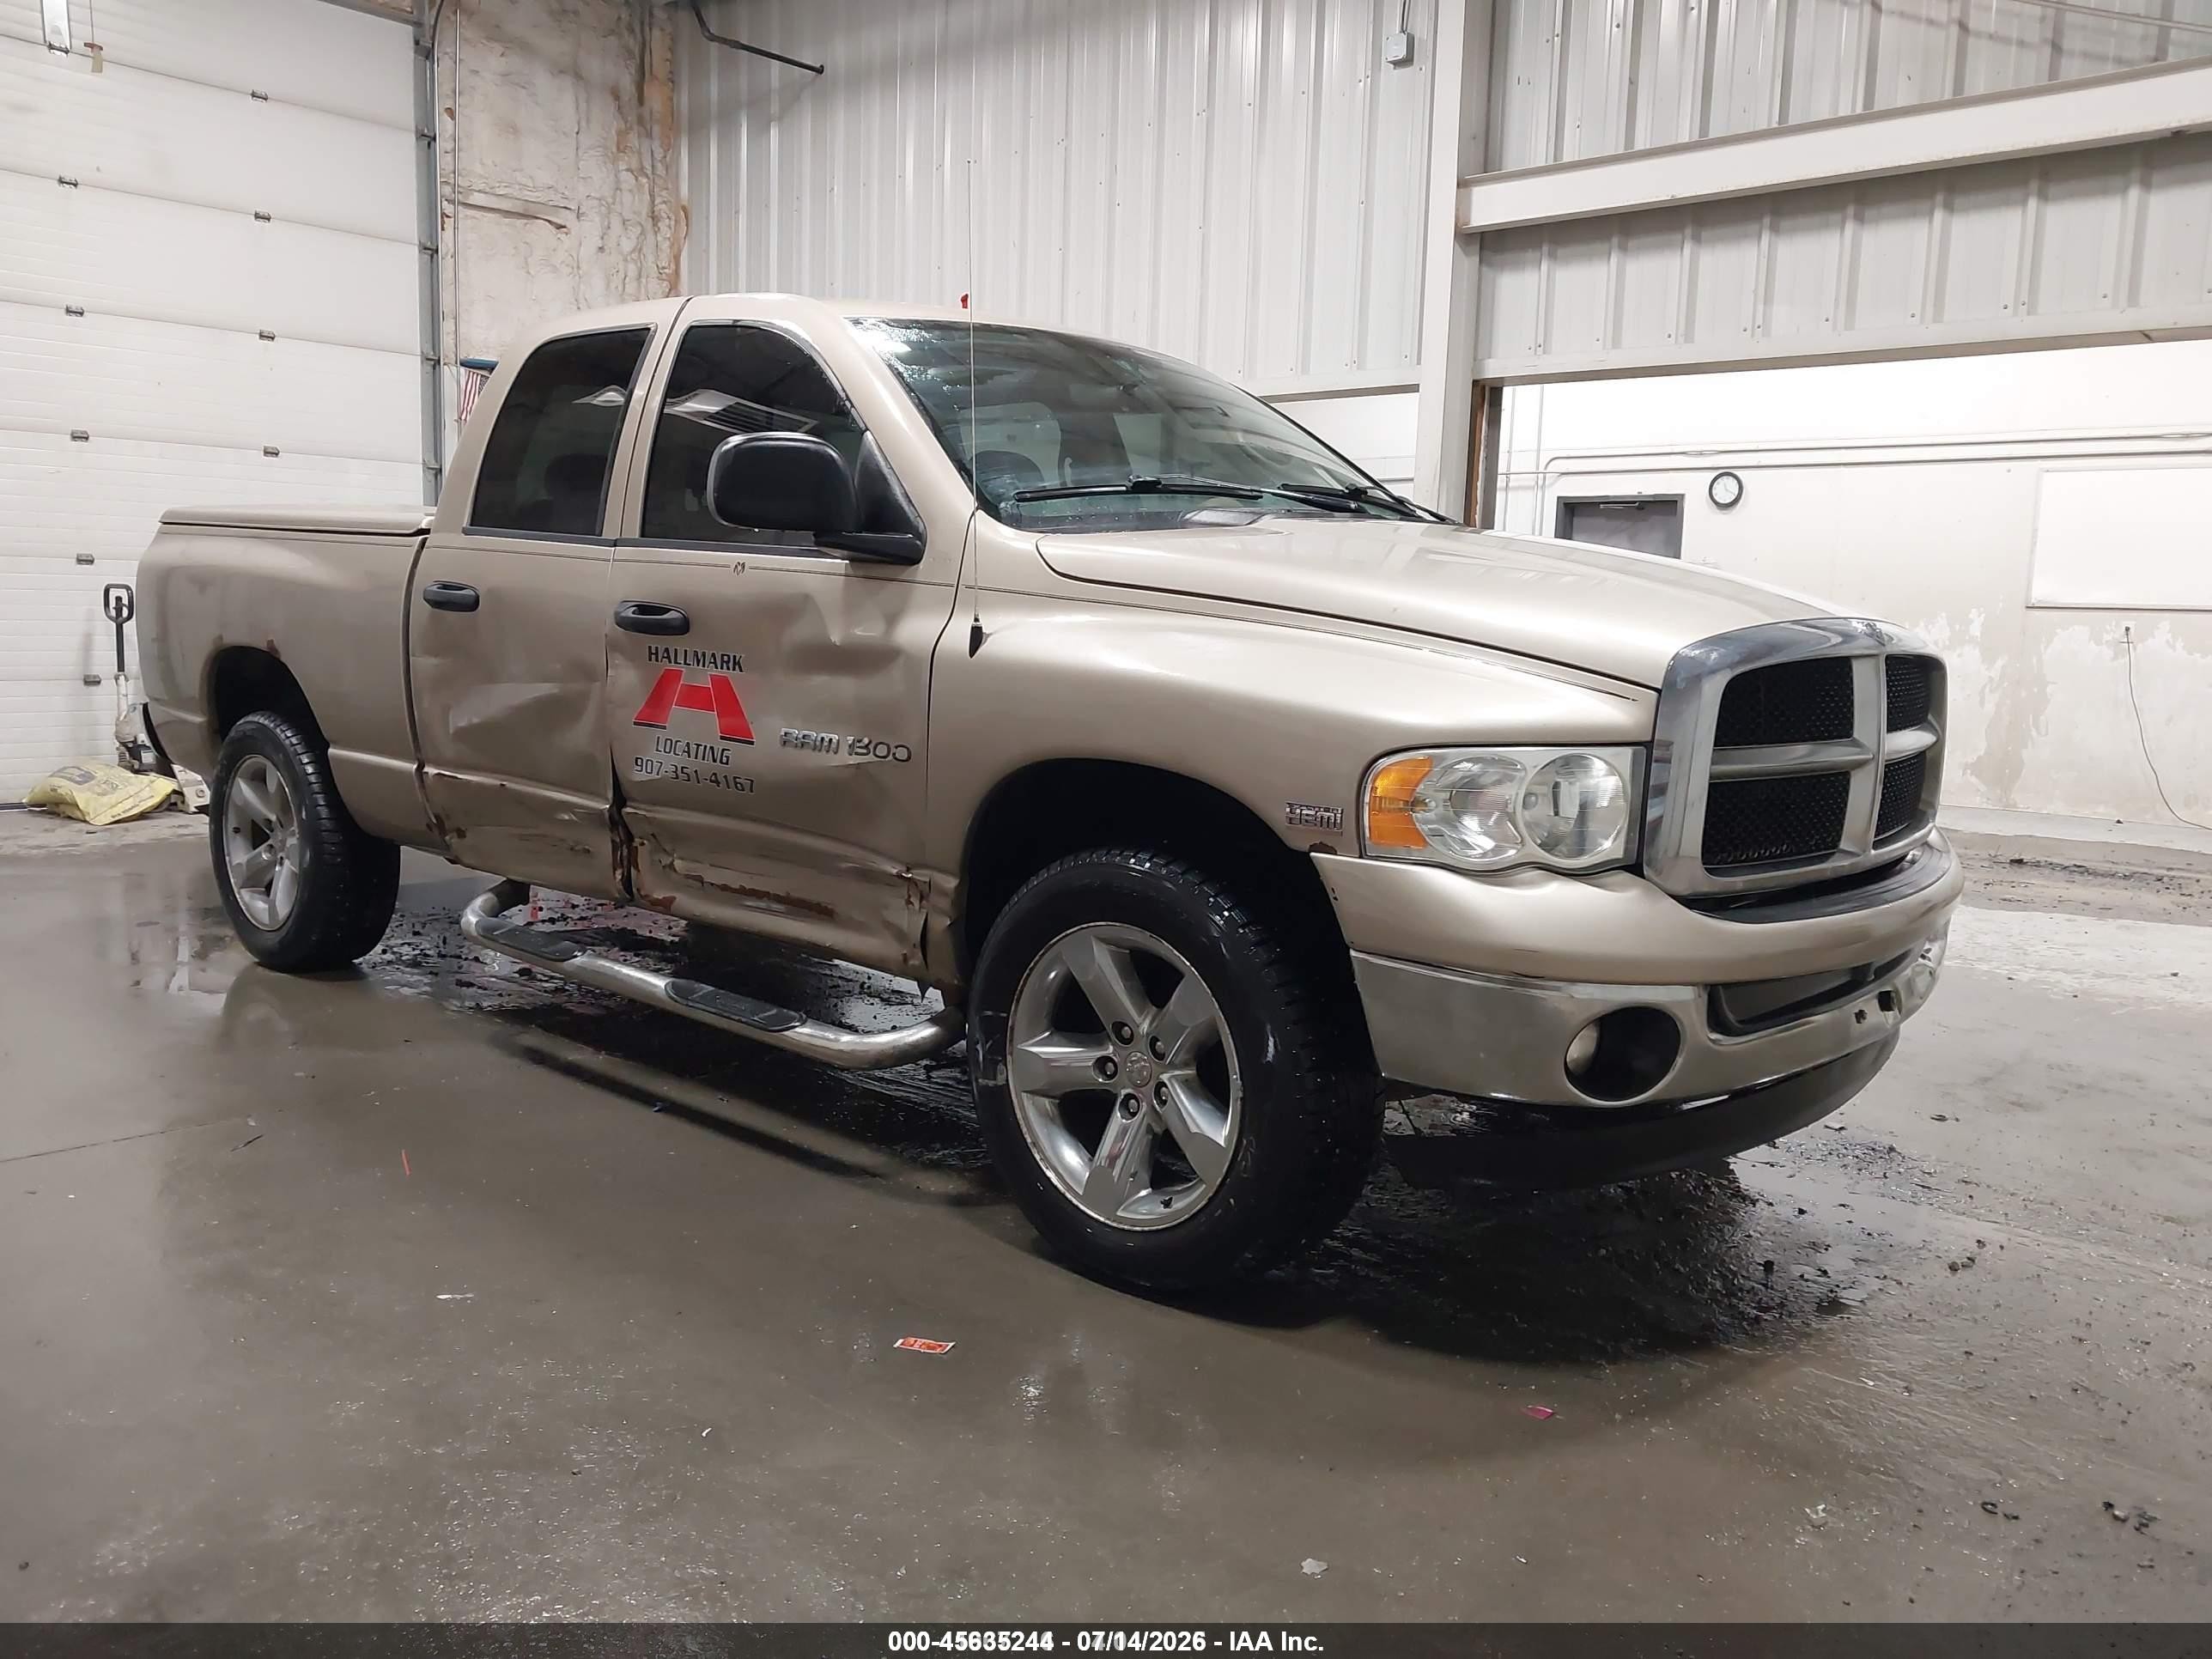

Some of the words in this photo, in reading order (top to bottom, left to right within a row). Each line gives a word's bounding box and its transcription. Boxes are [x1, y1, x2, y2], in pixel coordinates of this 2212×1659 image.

[647, 644, 744, 673] HALLMARK
[654, 735, 732, 766] LOCATING
[780, 727, 840, 756] RAM
[847, 735, 912, 763] 1500
[634, 756, 756, 793] 907-351-4167
